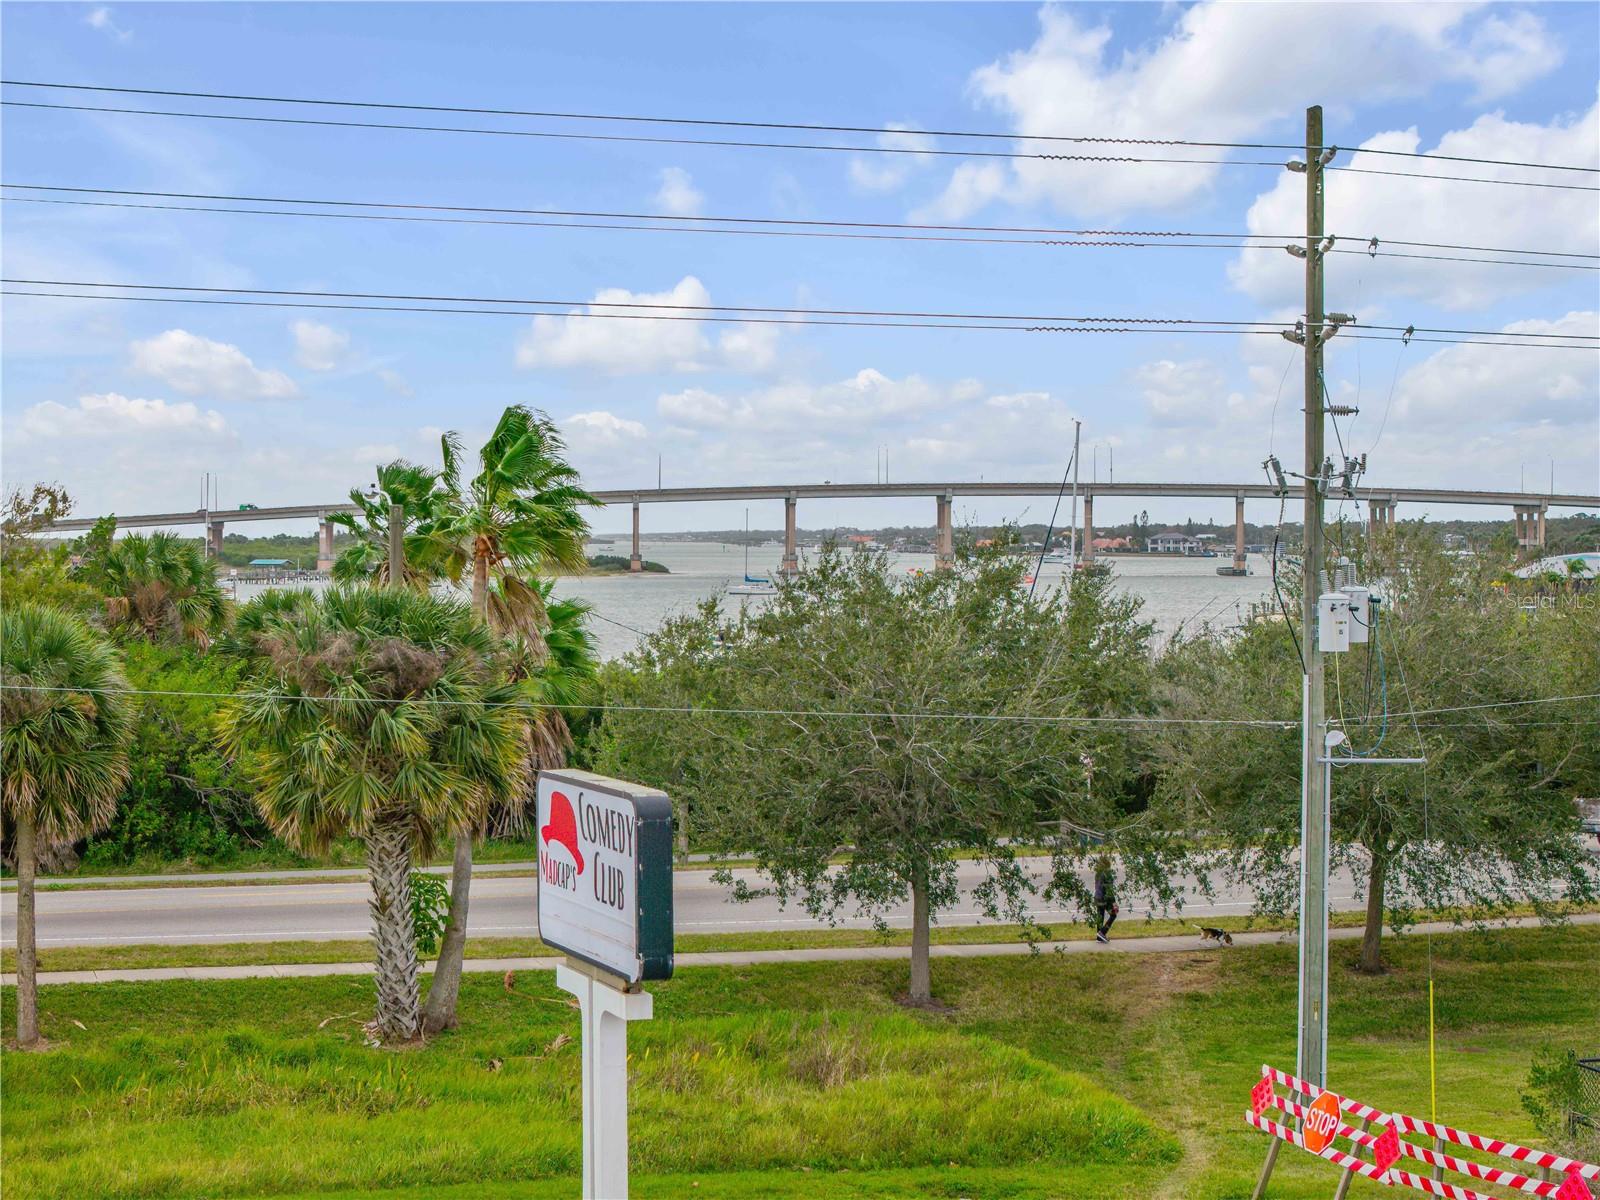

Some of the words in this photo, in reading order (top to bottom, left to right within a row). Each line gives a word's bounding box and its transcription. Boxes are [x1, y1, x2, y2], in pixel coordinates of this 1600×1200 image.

[578, 791, 635, 858] COMEDY
[540, 849, 577, 892] MADCAP'S
[593, 851, 625, 911] CLUB
[1306, 1107, 1338, 1137] STOP
